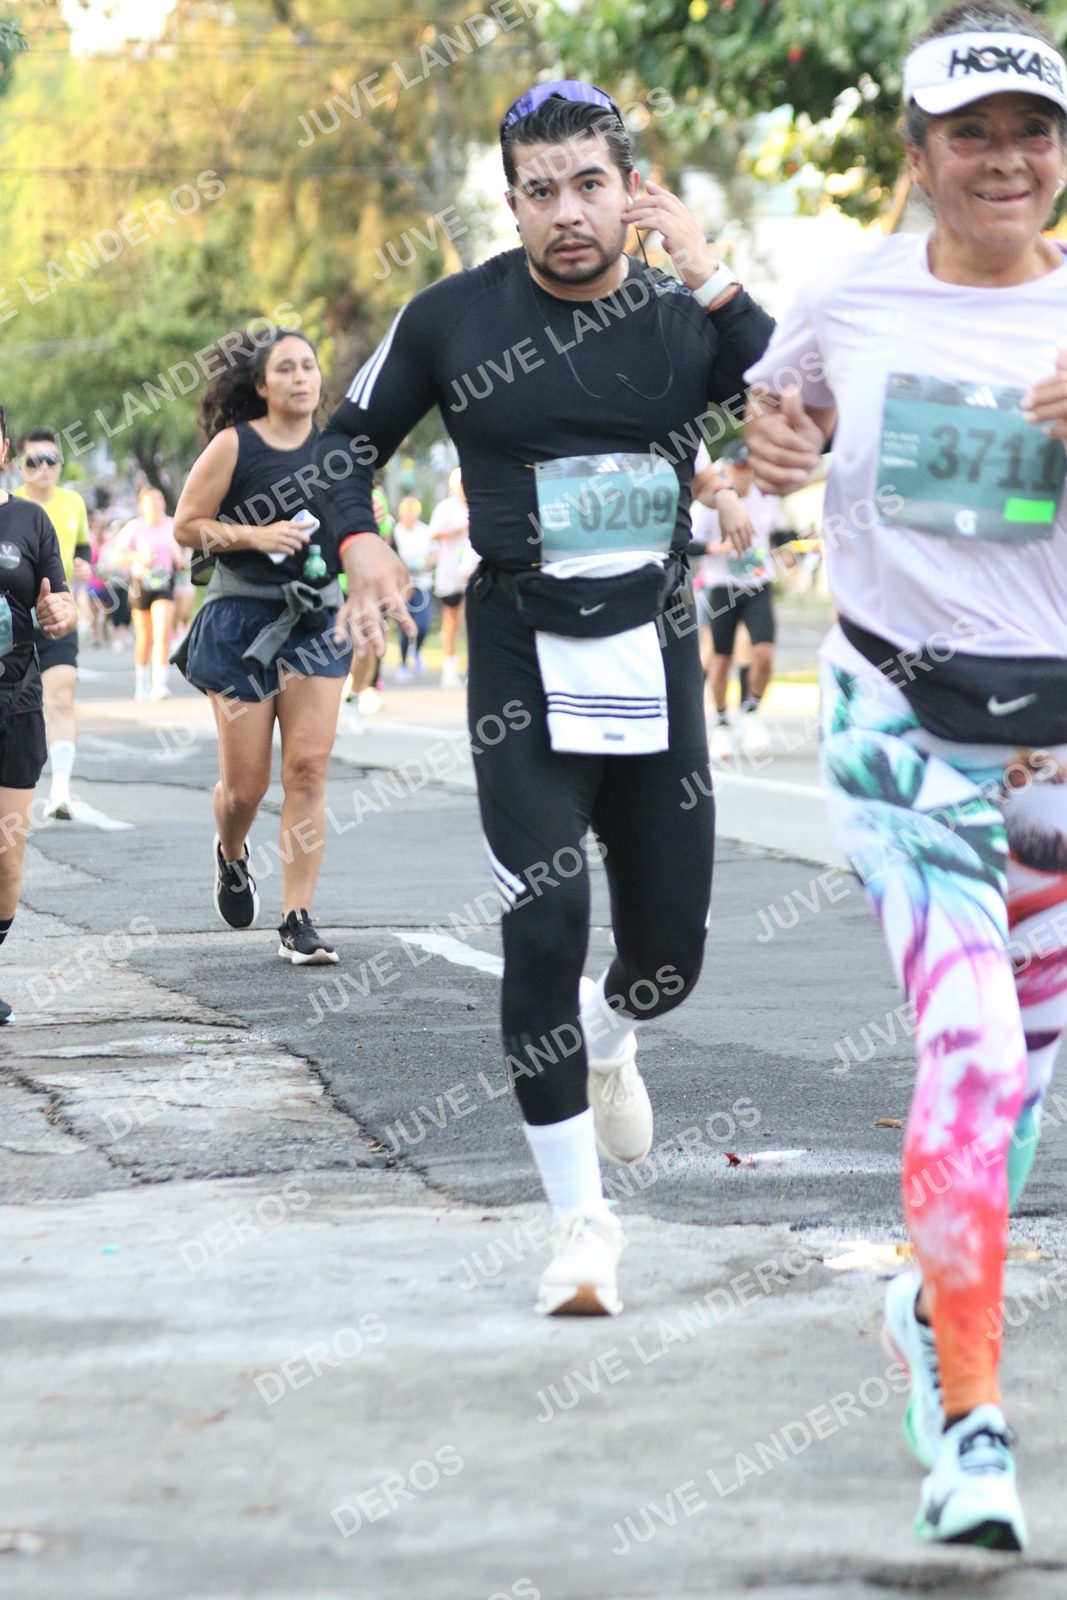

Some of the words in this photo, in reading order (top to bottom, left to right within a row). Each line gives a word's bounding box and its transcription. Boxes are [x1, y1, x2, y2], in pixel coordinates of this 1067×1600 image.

[948, 45, 1043, 81] HOKA
[927, 423, 1058, 492] 3711
[578, 485, 674, 533] 0209
